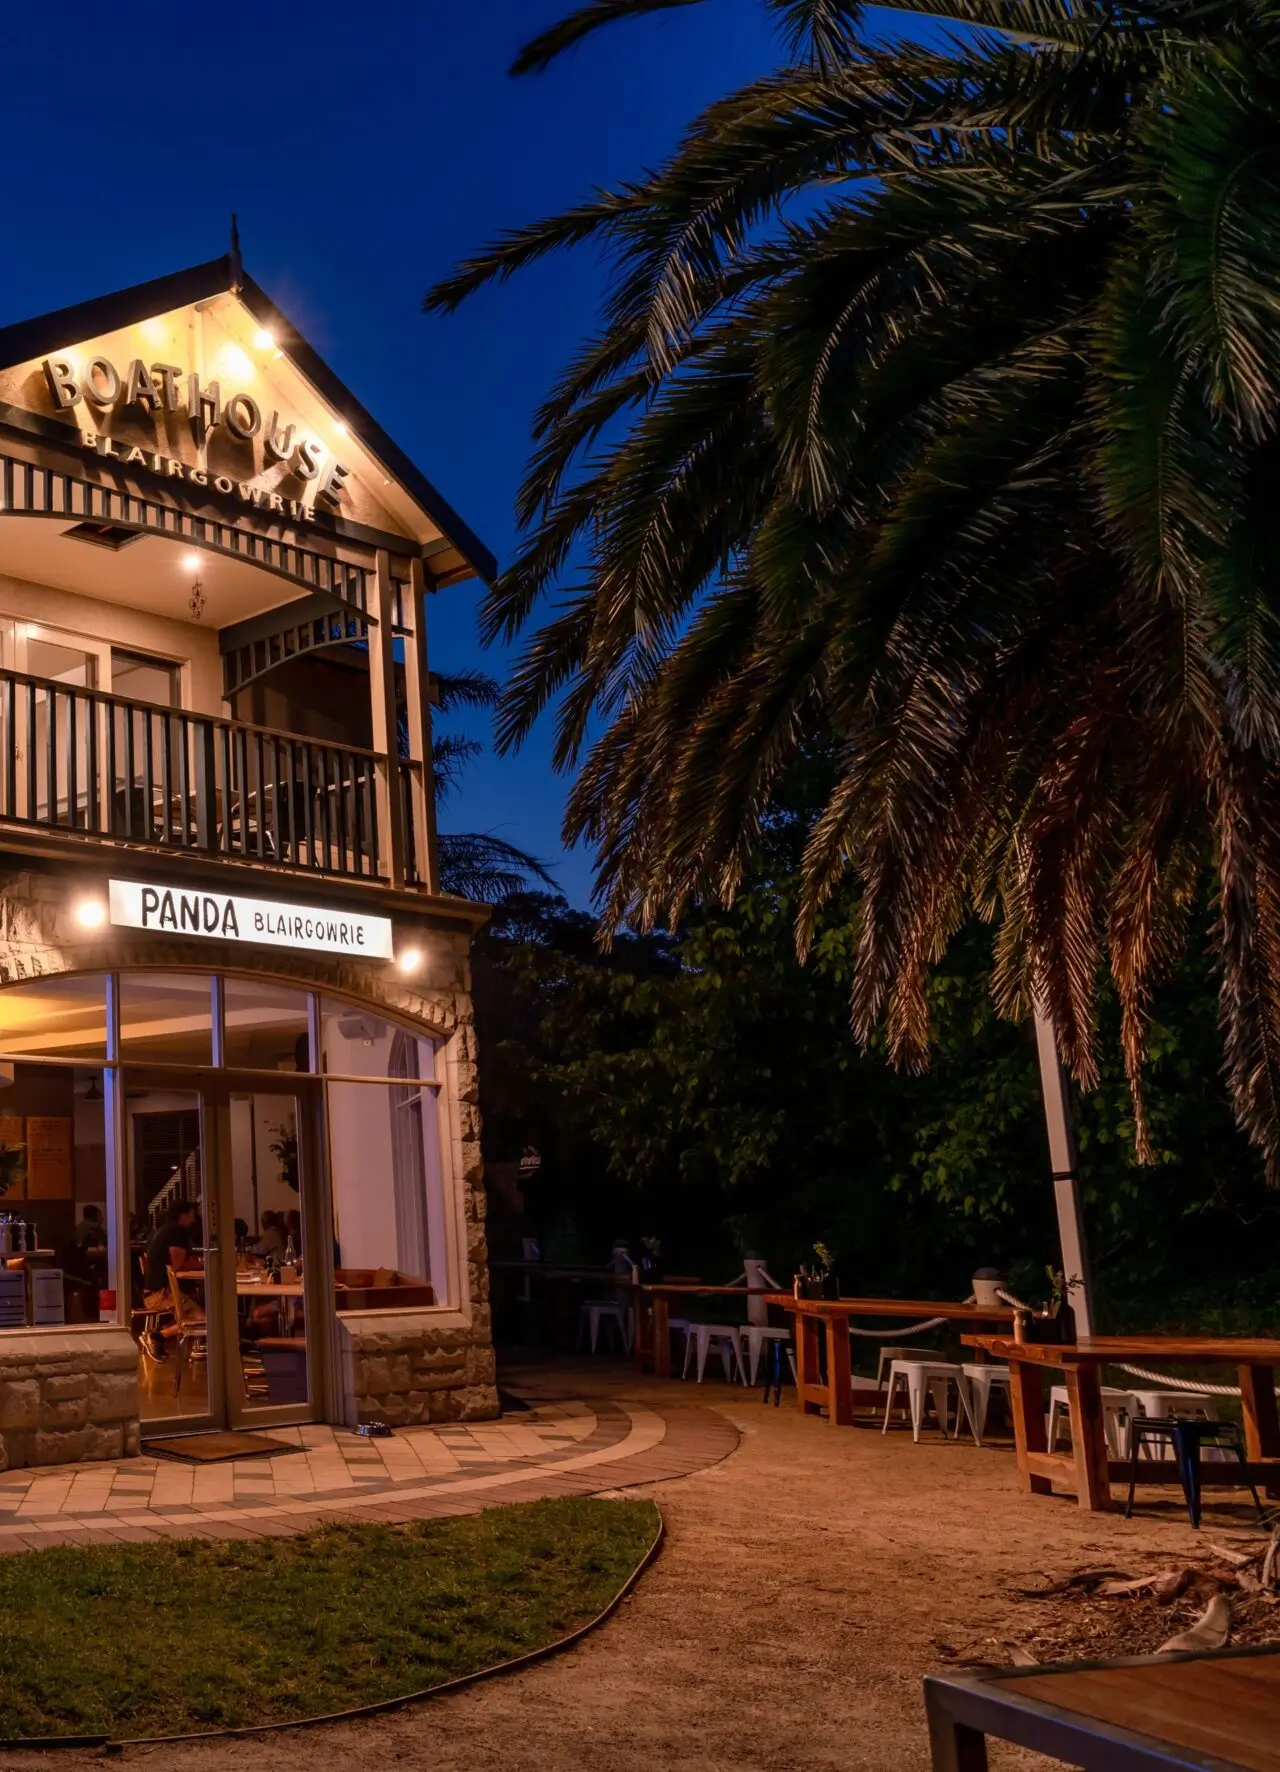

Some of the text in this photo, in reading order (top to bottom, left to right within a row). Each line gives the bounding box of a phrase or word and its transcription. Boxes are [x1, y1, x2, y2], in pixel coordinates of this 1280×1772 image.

[42, 356, 349, 507] BOATHOUSE
[81, 428, 316, 522] BLAIRGOWRIE
[141, 888, 365, 946] PANDA BLAIRGOWRIE
